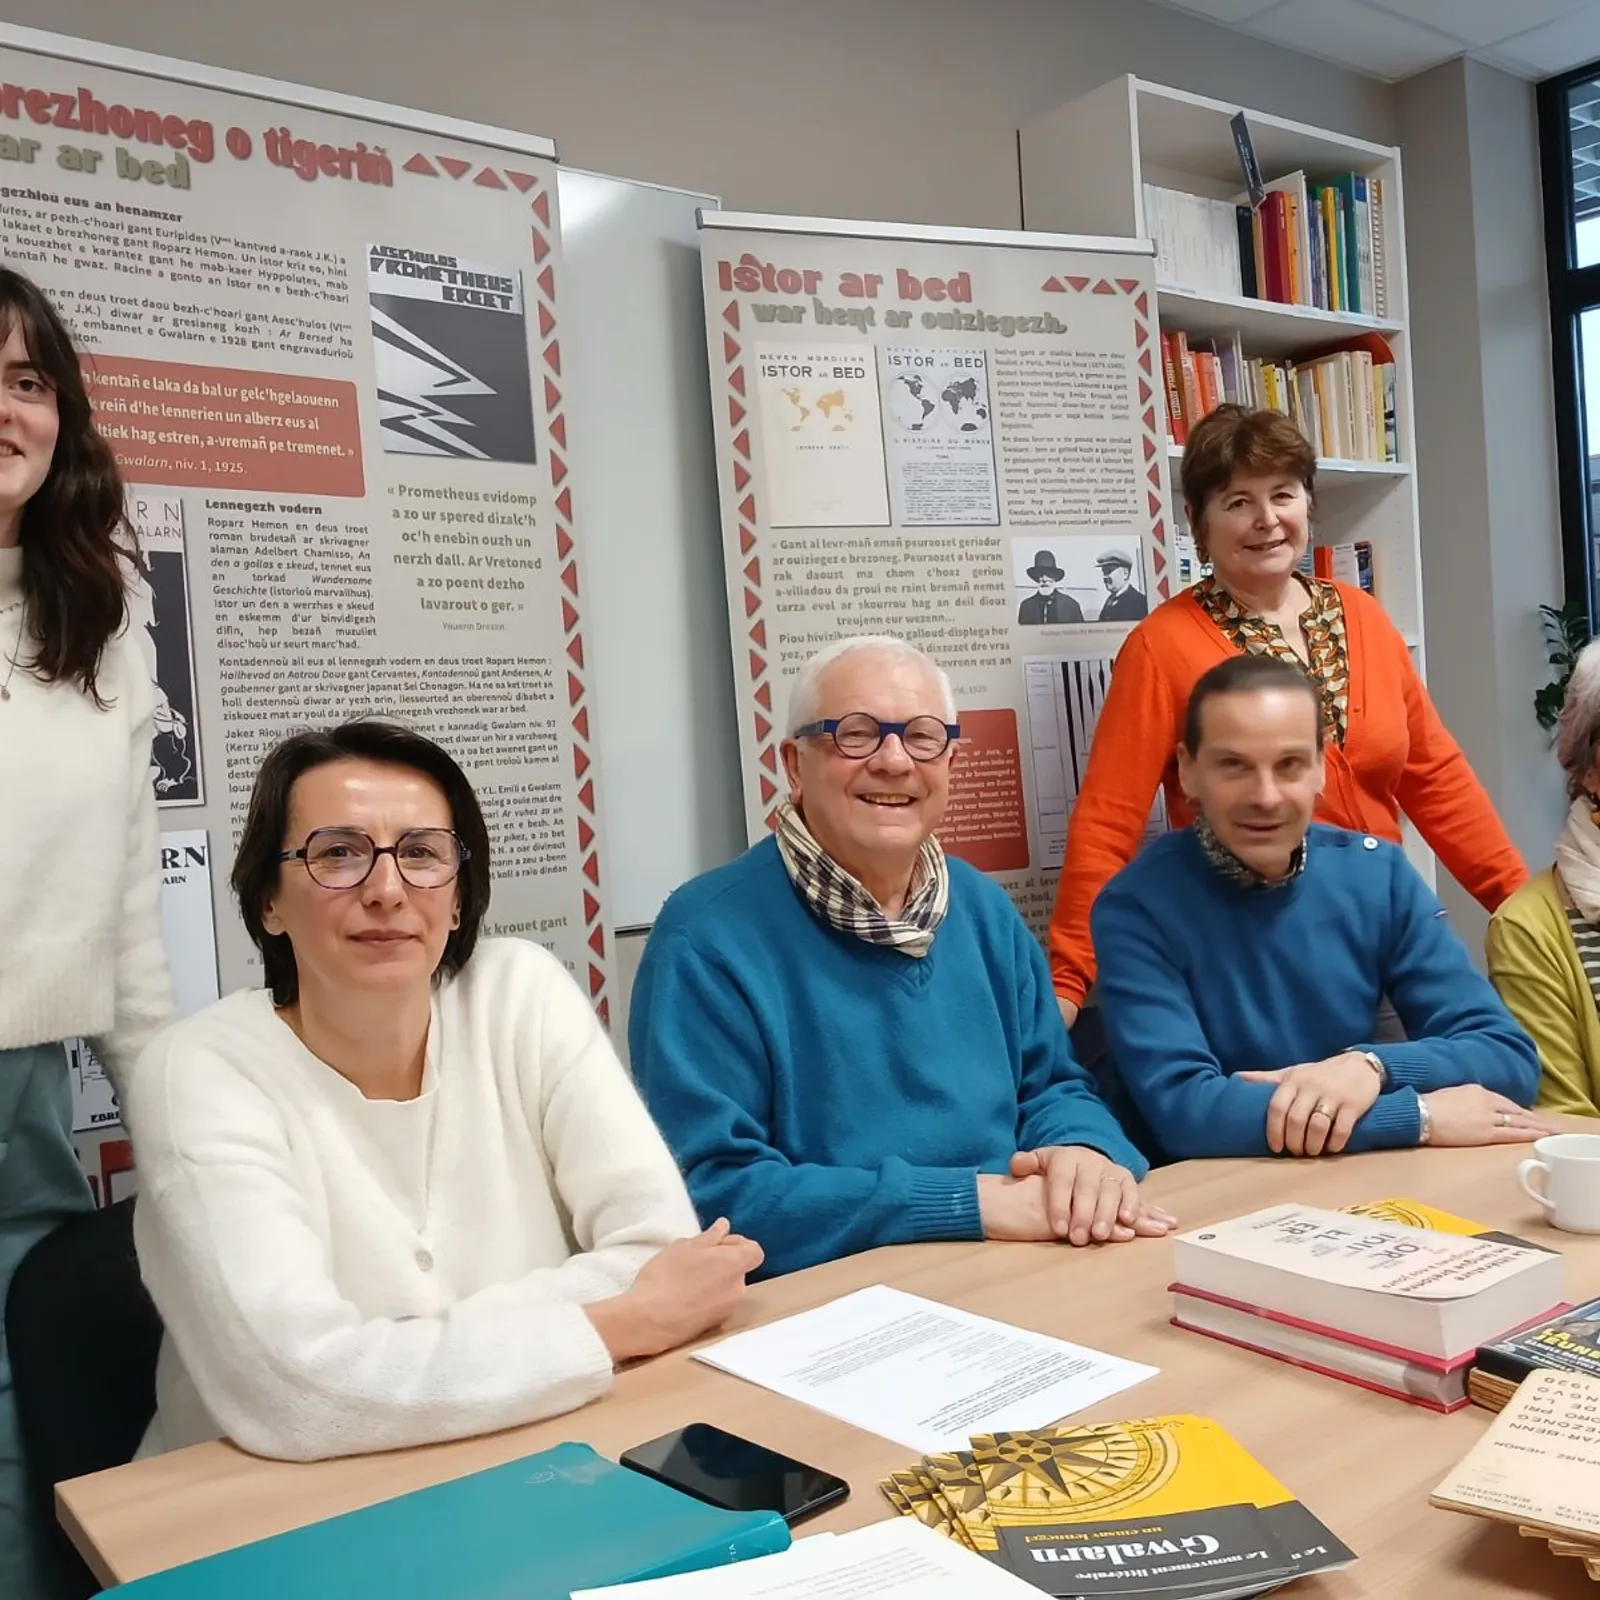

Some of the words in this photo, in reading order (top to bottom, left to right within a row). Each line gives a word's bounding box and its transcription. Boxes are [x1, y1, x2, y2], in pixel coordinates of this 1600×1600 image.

[0, 83, 214, 163] rezhoneg
[227, 127, 252, 160] o
[57, 145, 103, 174] ar
[116, 147, 191, 190] bed
[838, 270, 883, 299] ar
[897, 268, 972, 302] bed
[752, 302, 806, 324] war
[885, 308, 912, 328] ar
[762, 366, 812, 378] ISTOR
[833, 367, 865, 378] BED
[888, 356, 934, 366] ISTOR
[954, 358, 984, 368] BED
[92, 370, 140, 388] kentañ
[142, 378, 150, 389] e
[152, 376, 180, 392] laka
[183, 379, 199, 394] da
[201, 380, 221, 396] bal
[223, 387, 237, 398] ur
[240, 385, 338, 408] gelc'hgelaouenn
[100, 397, 126, 412] reiñ
[129, 399, 158, 415] d'he
[161, 402, 222, 421] lennerien
[225, 411, 241, 423] un
[244, 410, 282, 426] alberz
[284, 417, 306, 428] eus
[308, 416, 318, 430] al
[131, 425, 155, 444] hag
[158, 430, 204, 448] estren,
[206, 435, 267, 450] a-vremañ
[269, 440, 284, 454] pe
[286, 439, 344, 456] tremenet.
[115, 451, 172, 470] Gwalarn,
[201, 460, 211, 473] 1,
[215, 461, 246, 476] 1925.
[205, 500, 296, 512] Lennegezh
[278, 503, 322, 514] vodern
[398, 484, 480, 500] Prometheus
[482, 490, 537, 507] evidomp
[392, 509, 399, 518] a
[404, 509, 418, 519] zo
[422, 510, 436, 520] ur
[440, 511, 484, 524] spered
[487, 511, 535, 526] dizalc'h
[401, 530, 431, 543] oc'h
[433, 531, 479, 544] enebin
[481, 534, 513, 546] ouzh
[515, 537, 531, 548] un
[393, 551, 432, 565] nerzh
[435, 553, 464, 566] dall.
[467, 554, 482, 566] Ar
[484, 555, 541, 569] Vretoned
[417, 577, 424, 586] a
[427, 578, 442, 587] zo
[446, 578, 483, 591] poent
[487, 577, 524, 590] dezho
[420, 597, 478, 610] lavarout
[479, 601, 488, 610] o
[490, 601, 514, 614] ger.
[494, 920, 537, 936] krouet
[540, 916, 567, 932] gant
[1028, 1534, 1220, 1566] Gwalarn
